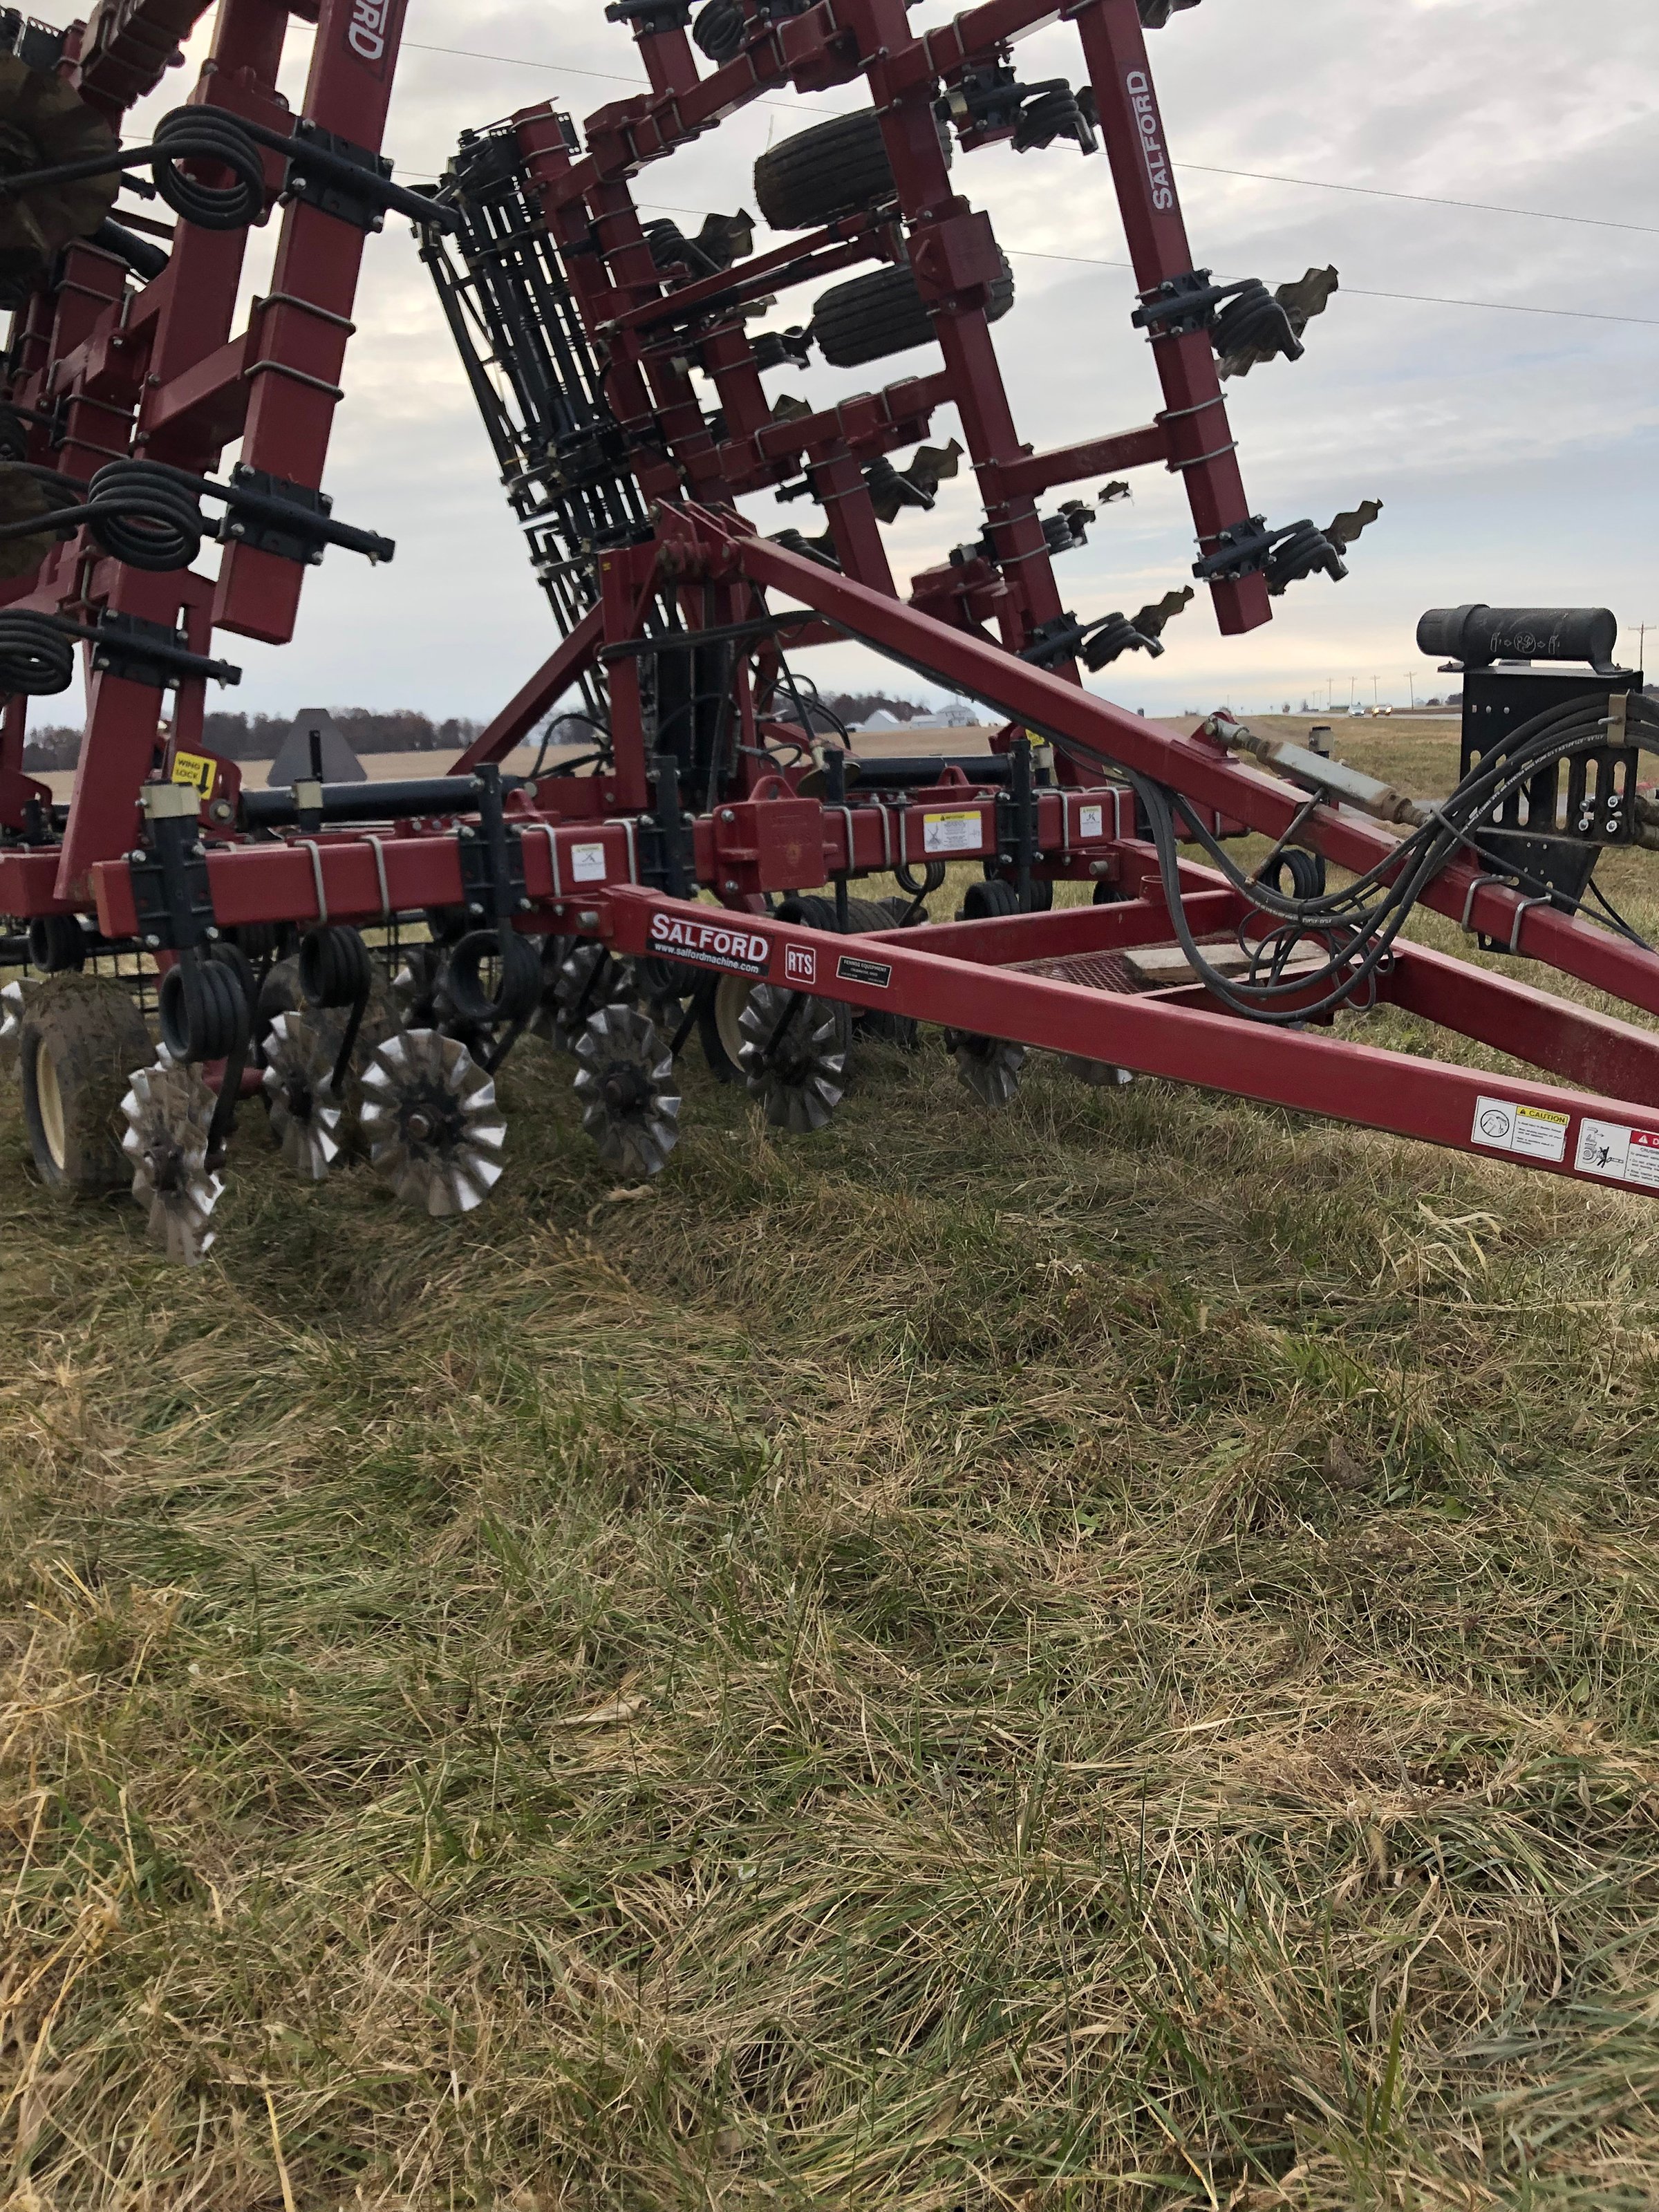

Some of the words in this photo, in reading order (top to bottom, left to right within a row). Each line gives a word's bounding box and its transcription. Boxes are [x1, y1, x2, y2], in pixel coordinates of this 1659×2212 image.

[1127, 71, 1173, 209] SALFORD
[176, 769, 198, 778] LOCK
[178, 760, 200, 770] WING
[651, 913, 769, 962] SALFORD
[655, 943, 759, 974] www.salfordmachine.com
[787, 950, 814, 975] RTS
[1528, 1110, 1566, 1123] CAUTION
